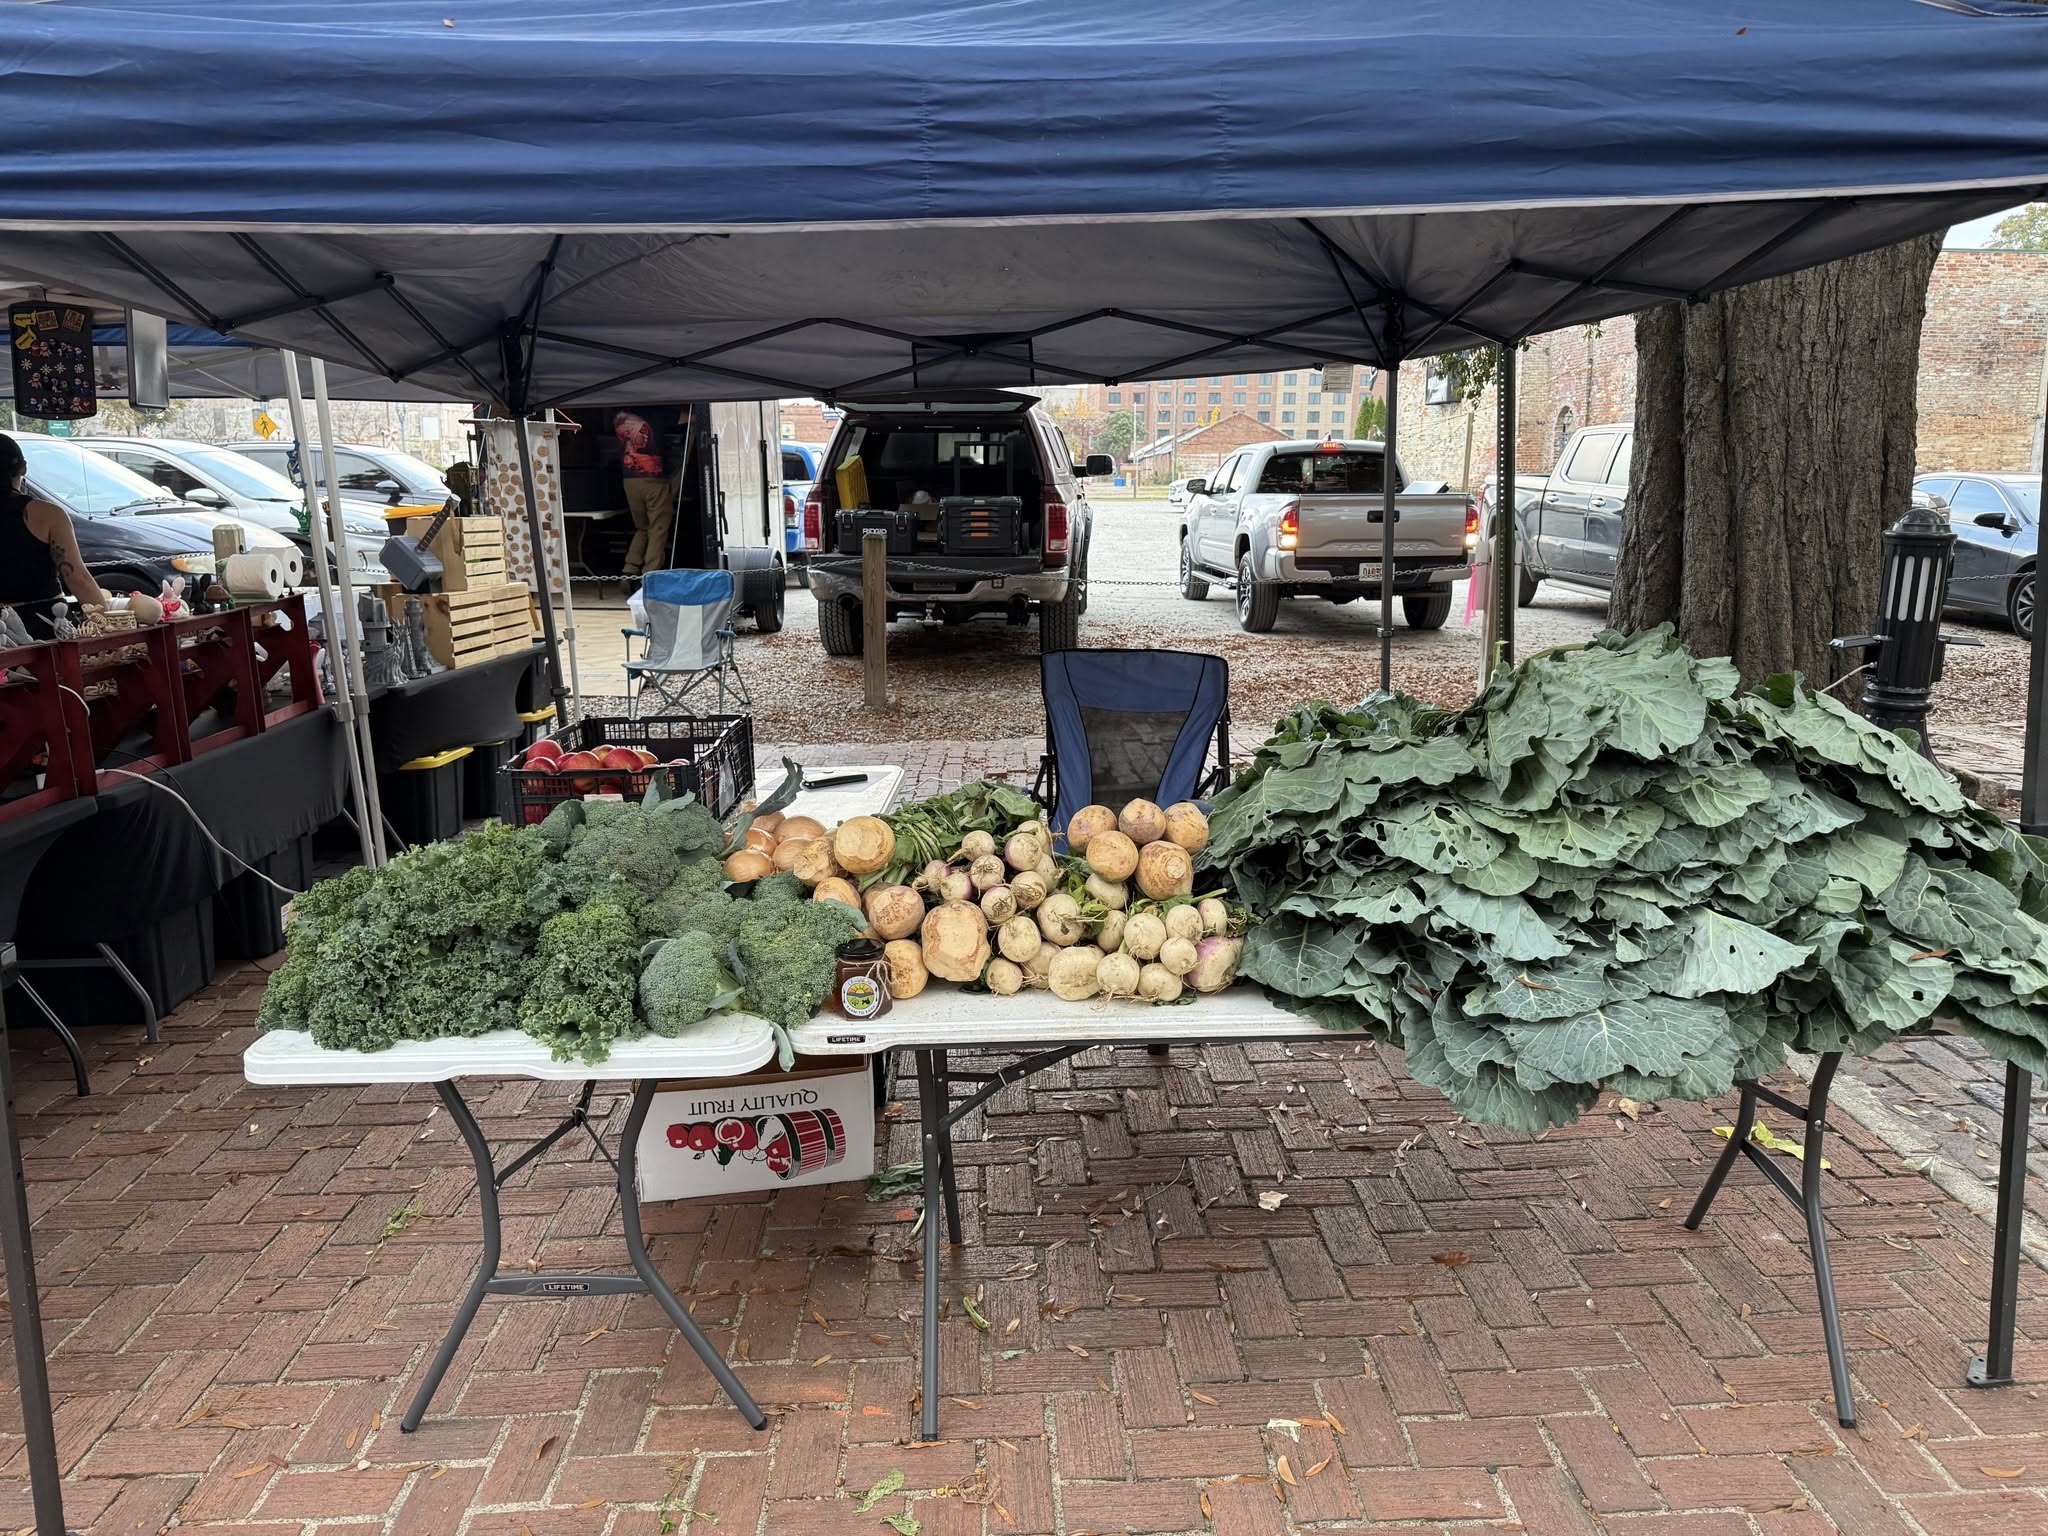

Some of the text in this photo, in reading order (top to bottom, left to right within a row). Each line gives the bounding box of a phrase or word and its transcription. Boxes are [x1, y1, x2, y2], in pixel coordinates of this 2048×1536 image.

[1334, 543, 1430, 551] TACMA
[688, 1088, 818, 1116] QUALITY FRUIT
